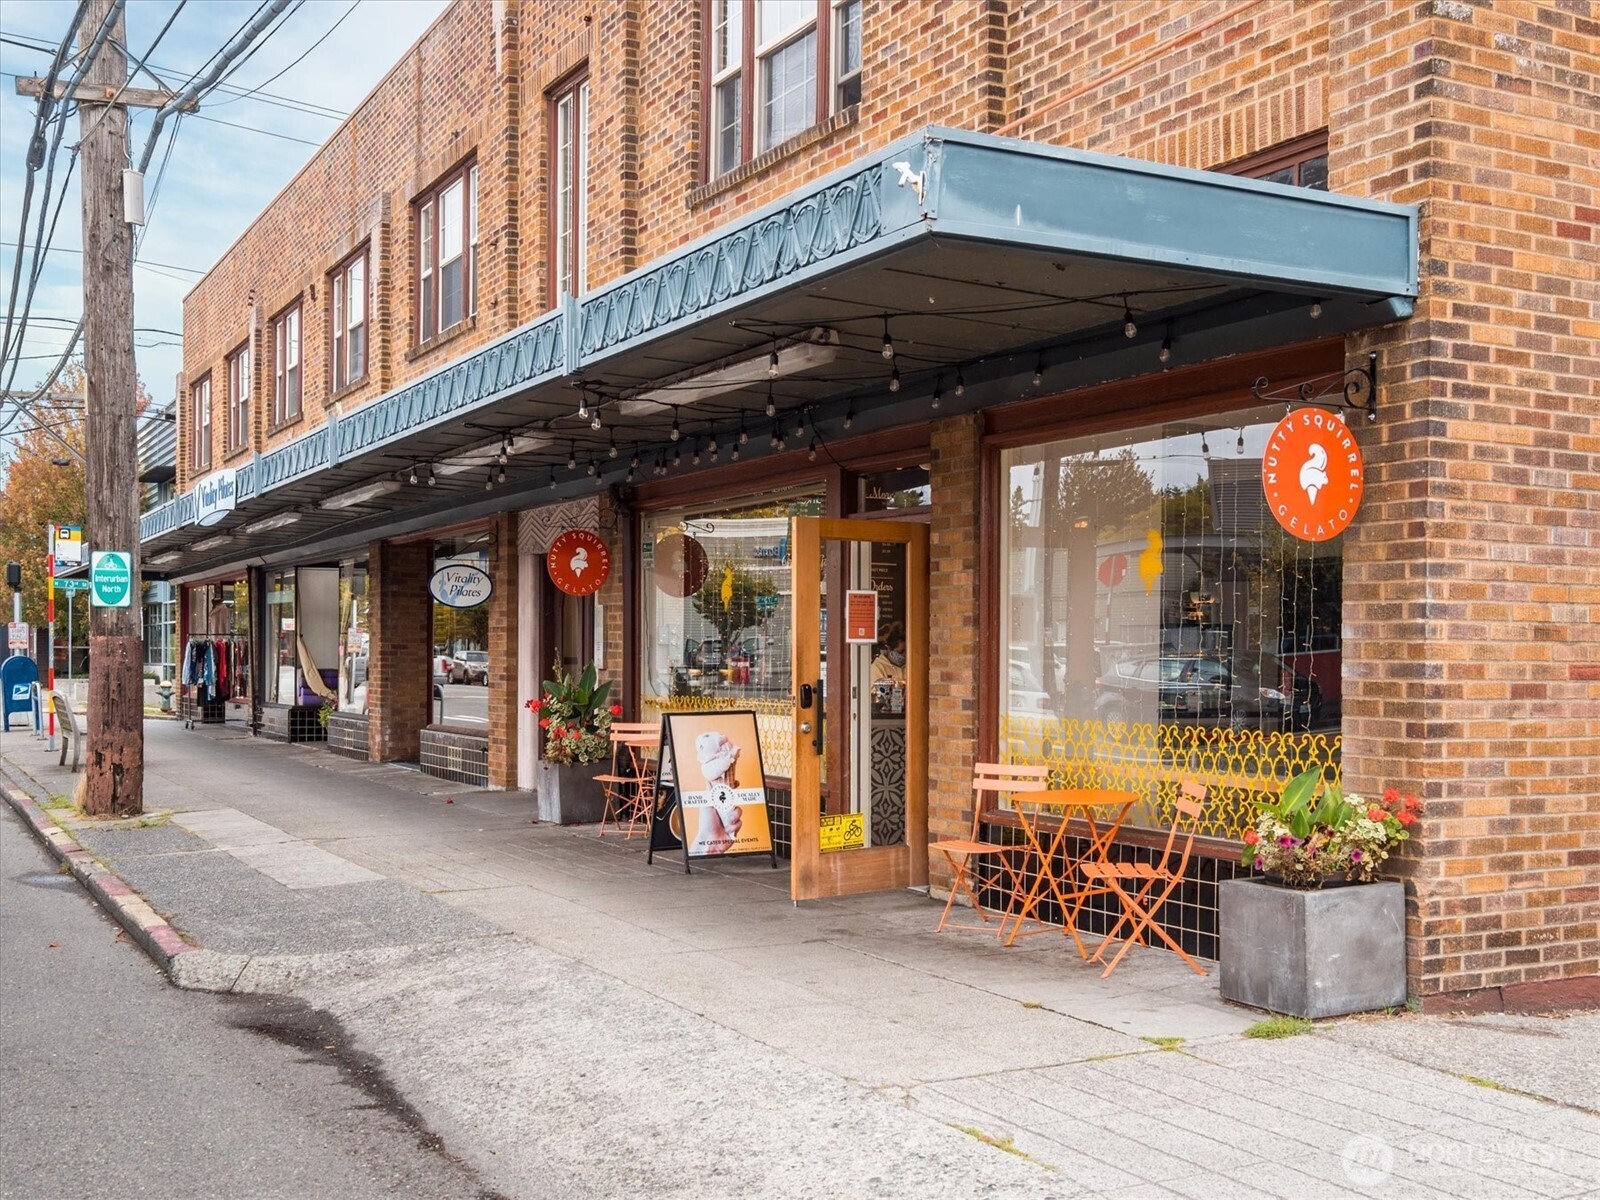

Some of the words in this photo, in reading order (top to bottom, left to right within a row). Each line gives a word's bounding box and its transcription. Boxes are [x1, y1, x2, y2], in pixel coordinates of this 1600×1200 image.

[1267, 422, 1294, 484] NUTTY
[1303, 414, 1360, 490] SQUIRREL
[1278, 504, 1348, 535] GELATO
[550, 536, 567, 569] NUTTY
[572, 532, 608, 570] SQUIRREL
[94, 574, 128, 583] Interurban
[446, 571, 484, 587] Vitality
[556, 577, 602, 593] GELATO
[102, 585, 122, 593] North
[449, 584, 482, 597] Pilates
